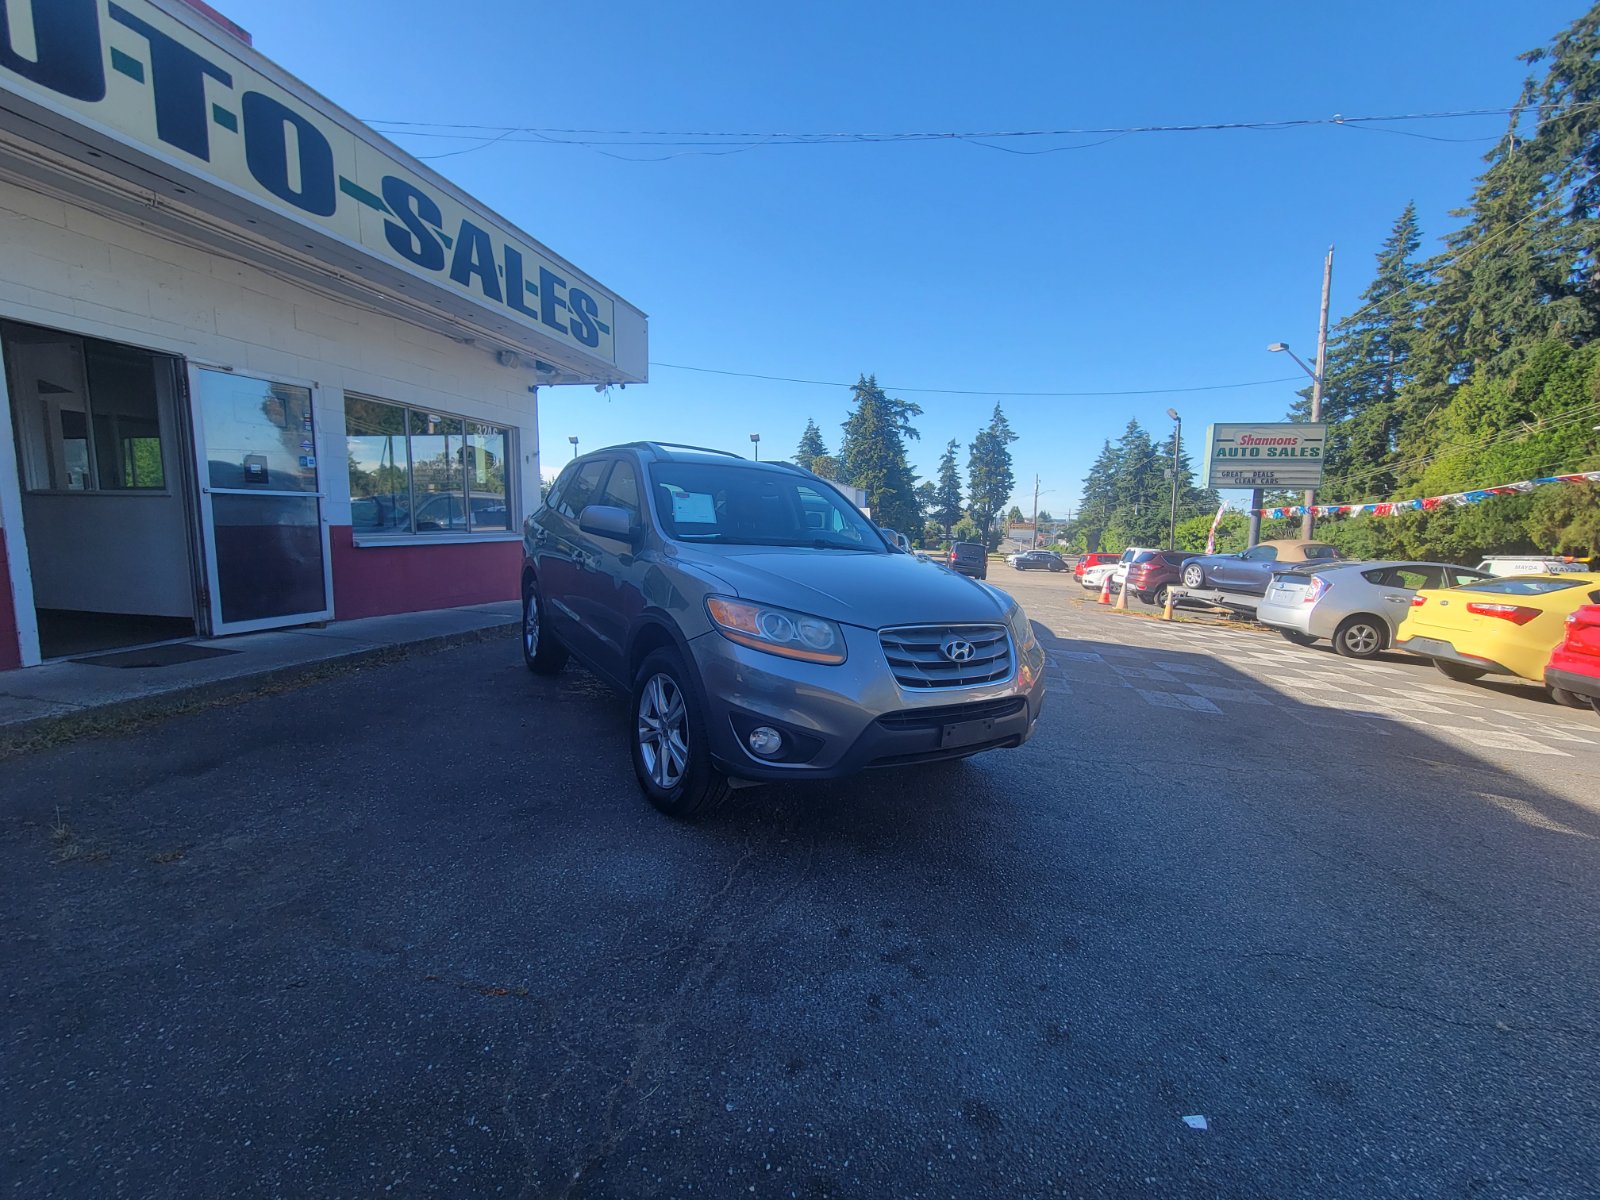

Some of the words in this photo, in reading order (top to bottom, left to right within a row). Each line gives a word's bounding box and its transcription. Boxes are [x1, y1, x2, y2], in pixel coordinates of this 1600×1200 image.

[381, 175, 600, 349] SALES
[1240, 434, 1298, 446] Shannons
[1216, 447, 1260, 457] AUTO
[1266, 447, 1320, 457] SALES
